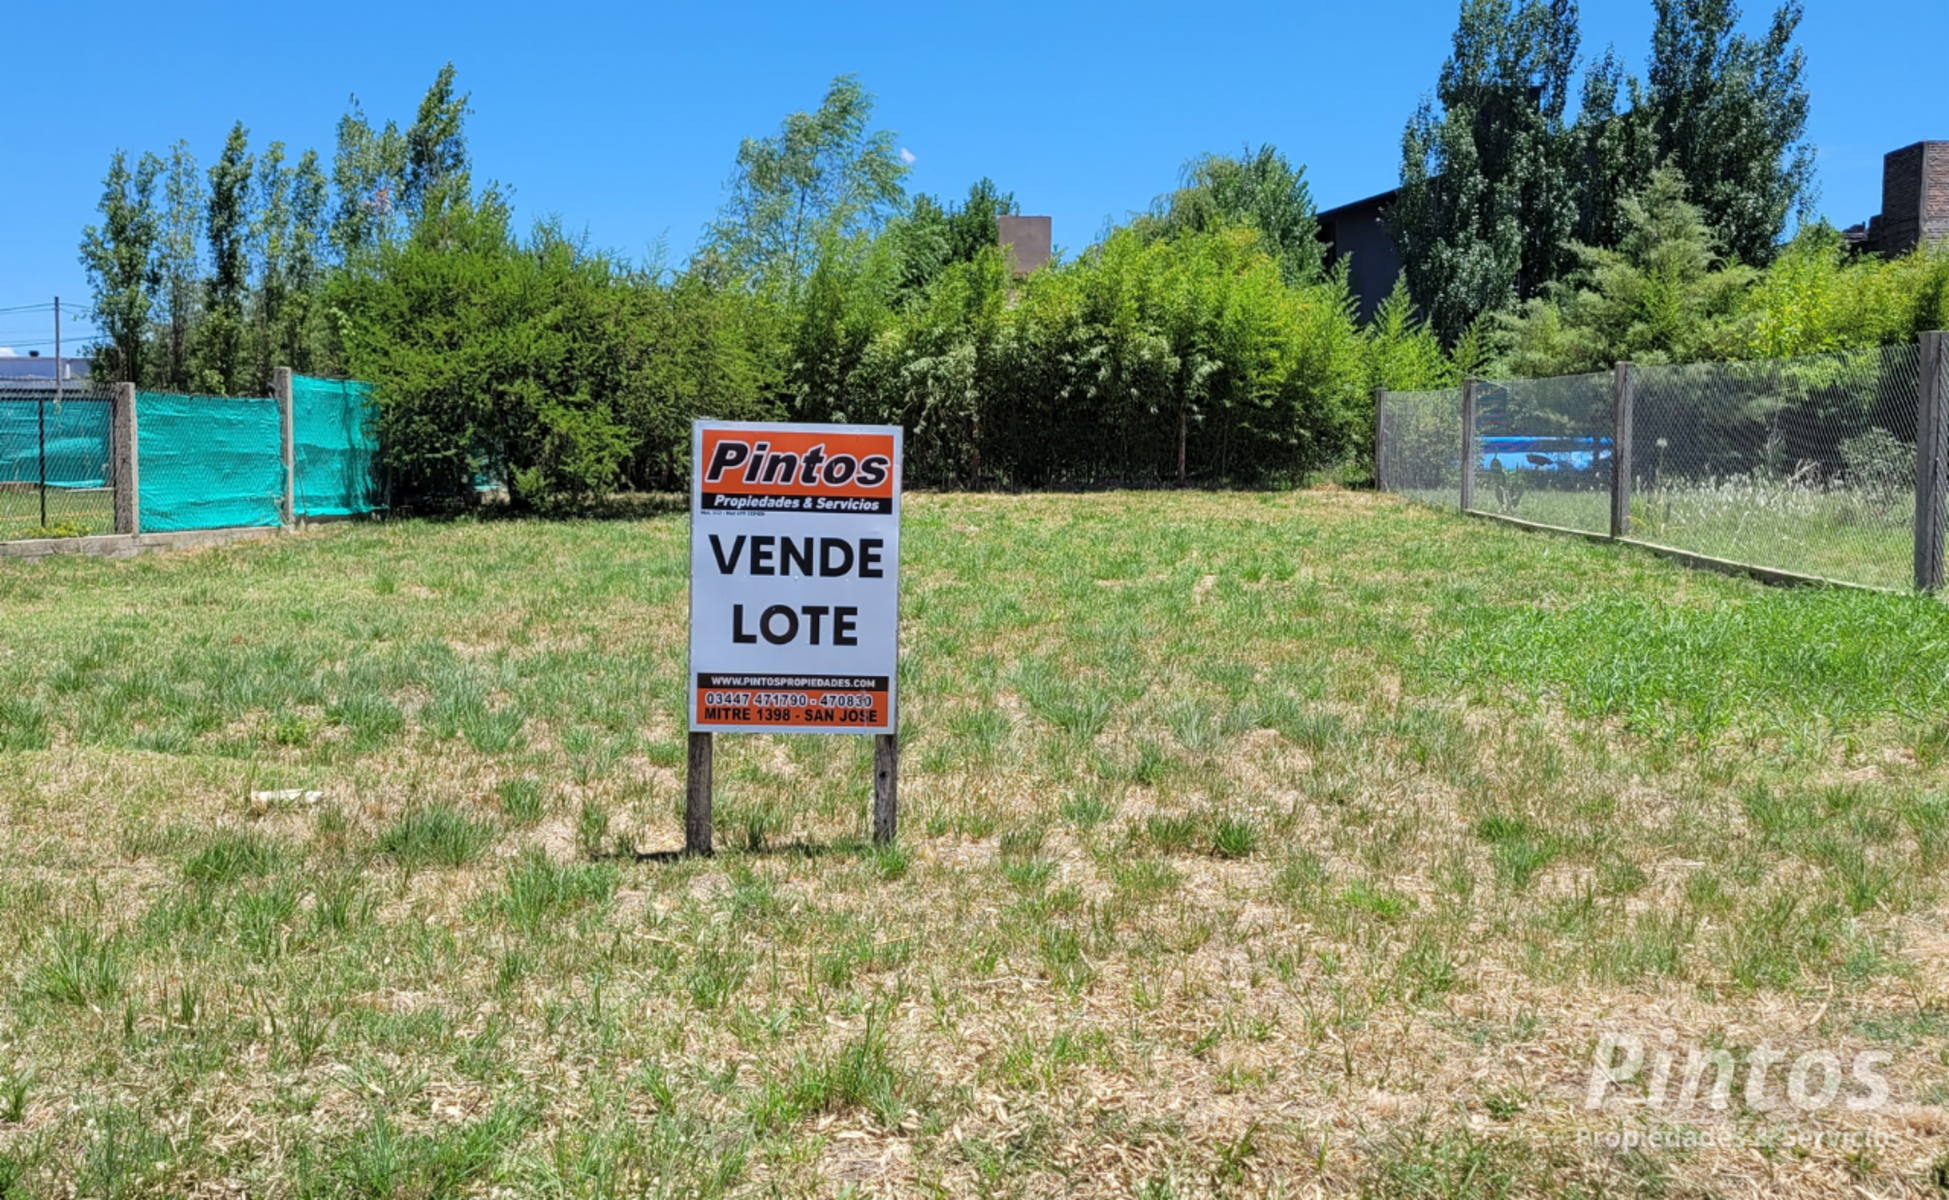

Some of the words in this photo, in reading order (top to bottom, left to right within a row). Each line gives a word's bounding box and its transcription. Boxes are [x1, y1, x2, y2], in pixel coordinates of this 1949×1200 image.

[705, 439, 891, 487] Pintos
[714, 494, 800, 510] Propiedades
[804, 496, 813, 509] &
[816, 497, 879, 511] Servicios
[708, 534, 884, 578] VENDE
[733, 604, 858, 646] LOTE
[711, 676, 876, 688] WWW.PINTOSPROPIEDADES.COM
[705, 692, 751, 706] 03447
[753, 693, 807, 707] 471790
[819, 694, 872, 707] 470830
[704, 707, 751, 721] MITRE
[756, 708, 791, 721] 1398
[804, 709, 834, 722] SAN
[839, 709, 878, 723] JOSE
